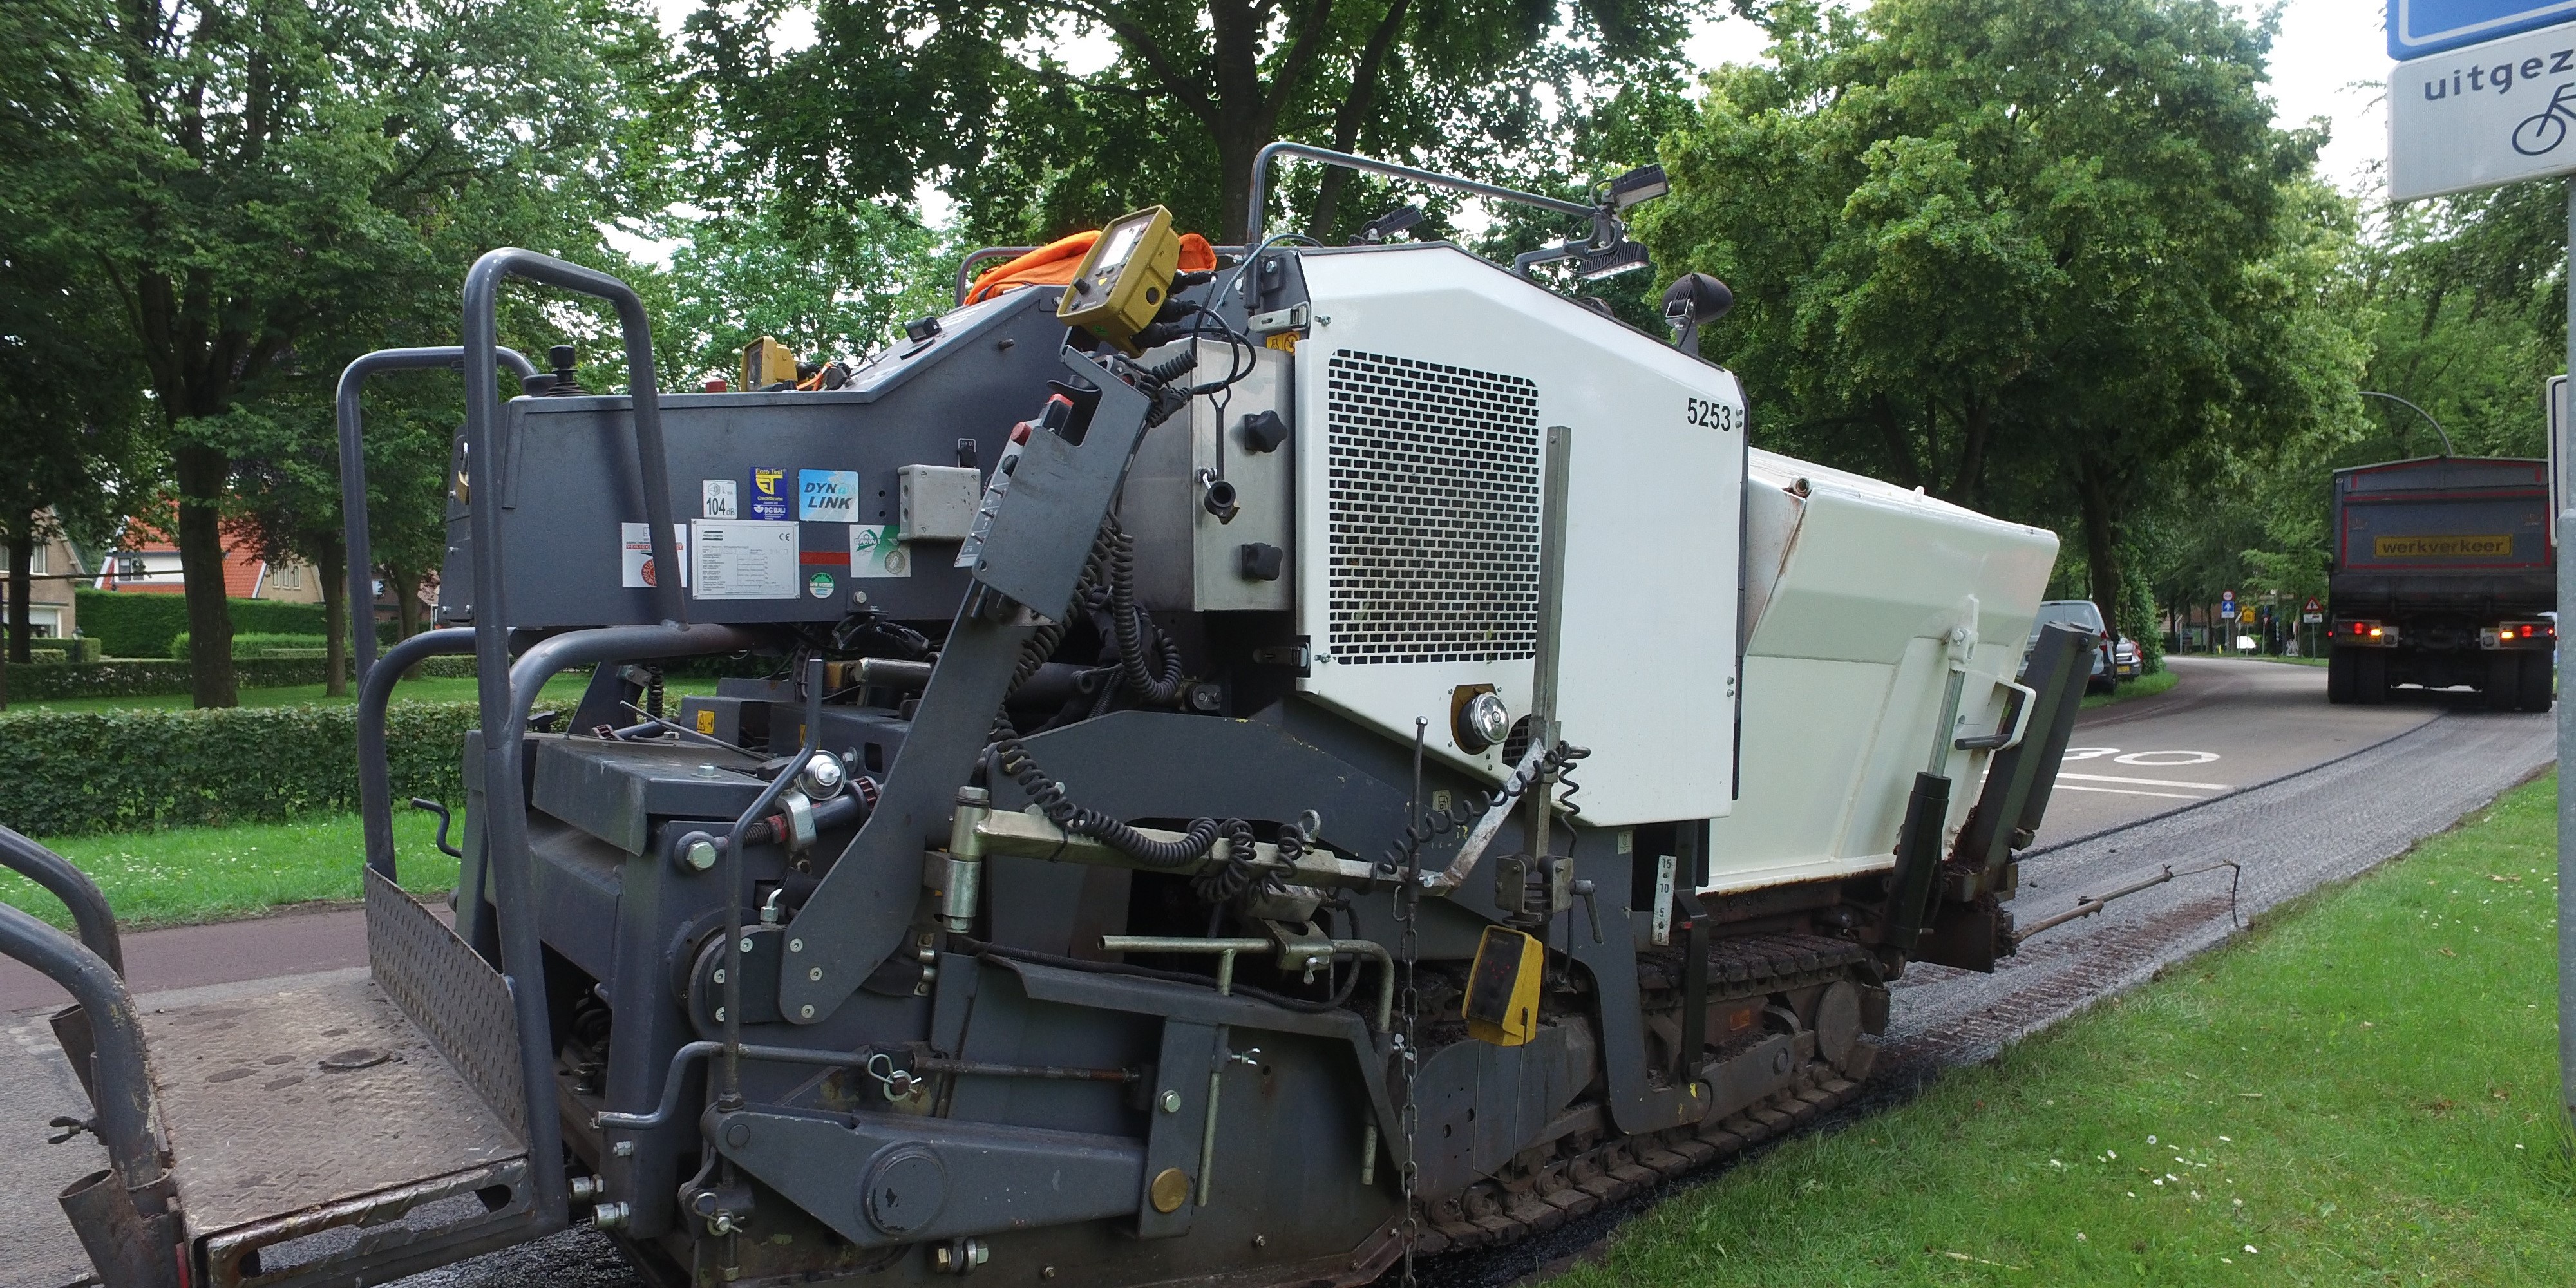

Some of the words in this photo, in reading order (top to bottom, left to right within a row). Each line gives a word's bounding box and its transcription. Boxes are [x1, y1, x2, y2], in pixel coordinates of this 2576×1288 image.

[2425, 48, 2574, 100] uitgez
[1687, 397, 1730, 431] 5253
[706, 497, 726, 515] 104
[726, 507, 735, 516] dB
[807, 496, 853, 509] LINK
[779, 533, 790, 541] CE
[2383, 539, 2504, 554] werkverkeer
[1662, 858, 1672, 869] 15
[1660, 883, 1669, 893] 10
[1659, 908, 1665, 918] 5
[1657, 932, 1662, 942] 0
